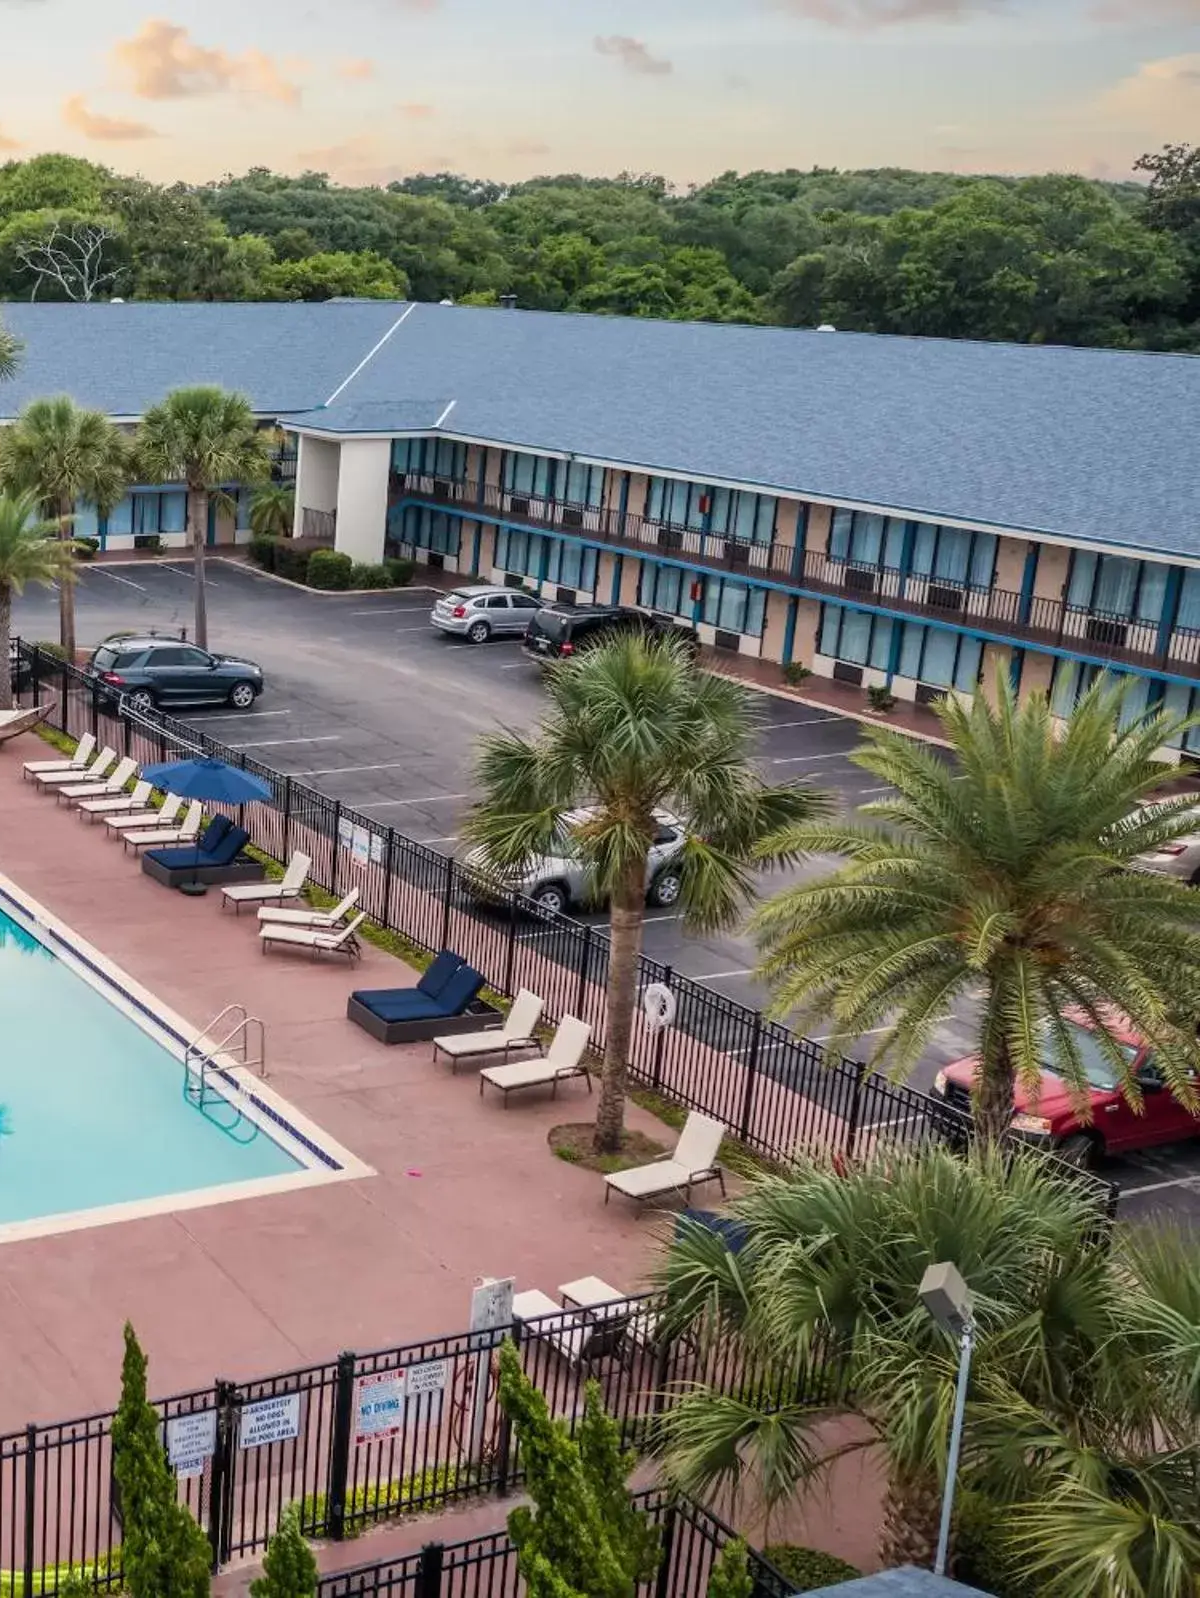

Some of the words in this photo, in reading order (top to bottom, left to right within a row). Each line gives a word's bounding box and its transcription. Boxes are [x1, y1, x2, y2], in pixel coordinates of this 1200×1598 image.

[361, 1404, 372, 1416] NO
[374, 1399, 400, 1413] DIVING
[256, 1413, 266, 1422] NO
[267, 1409, 285, 1420] DOGS
[249, 1420, 281, 1434] ALLOWED
[244, 1436, 257, 1445] THE
[259, 1431, 275, 1441] POOL
[276, 1426, 295, 1437] AREA
